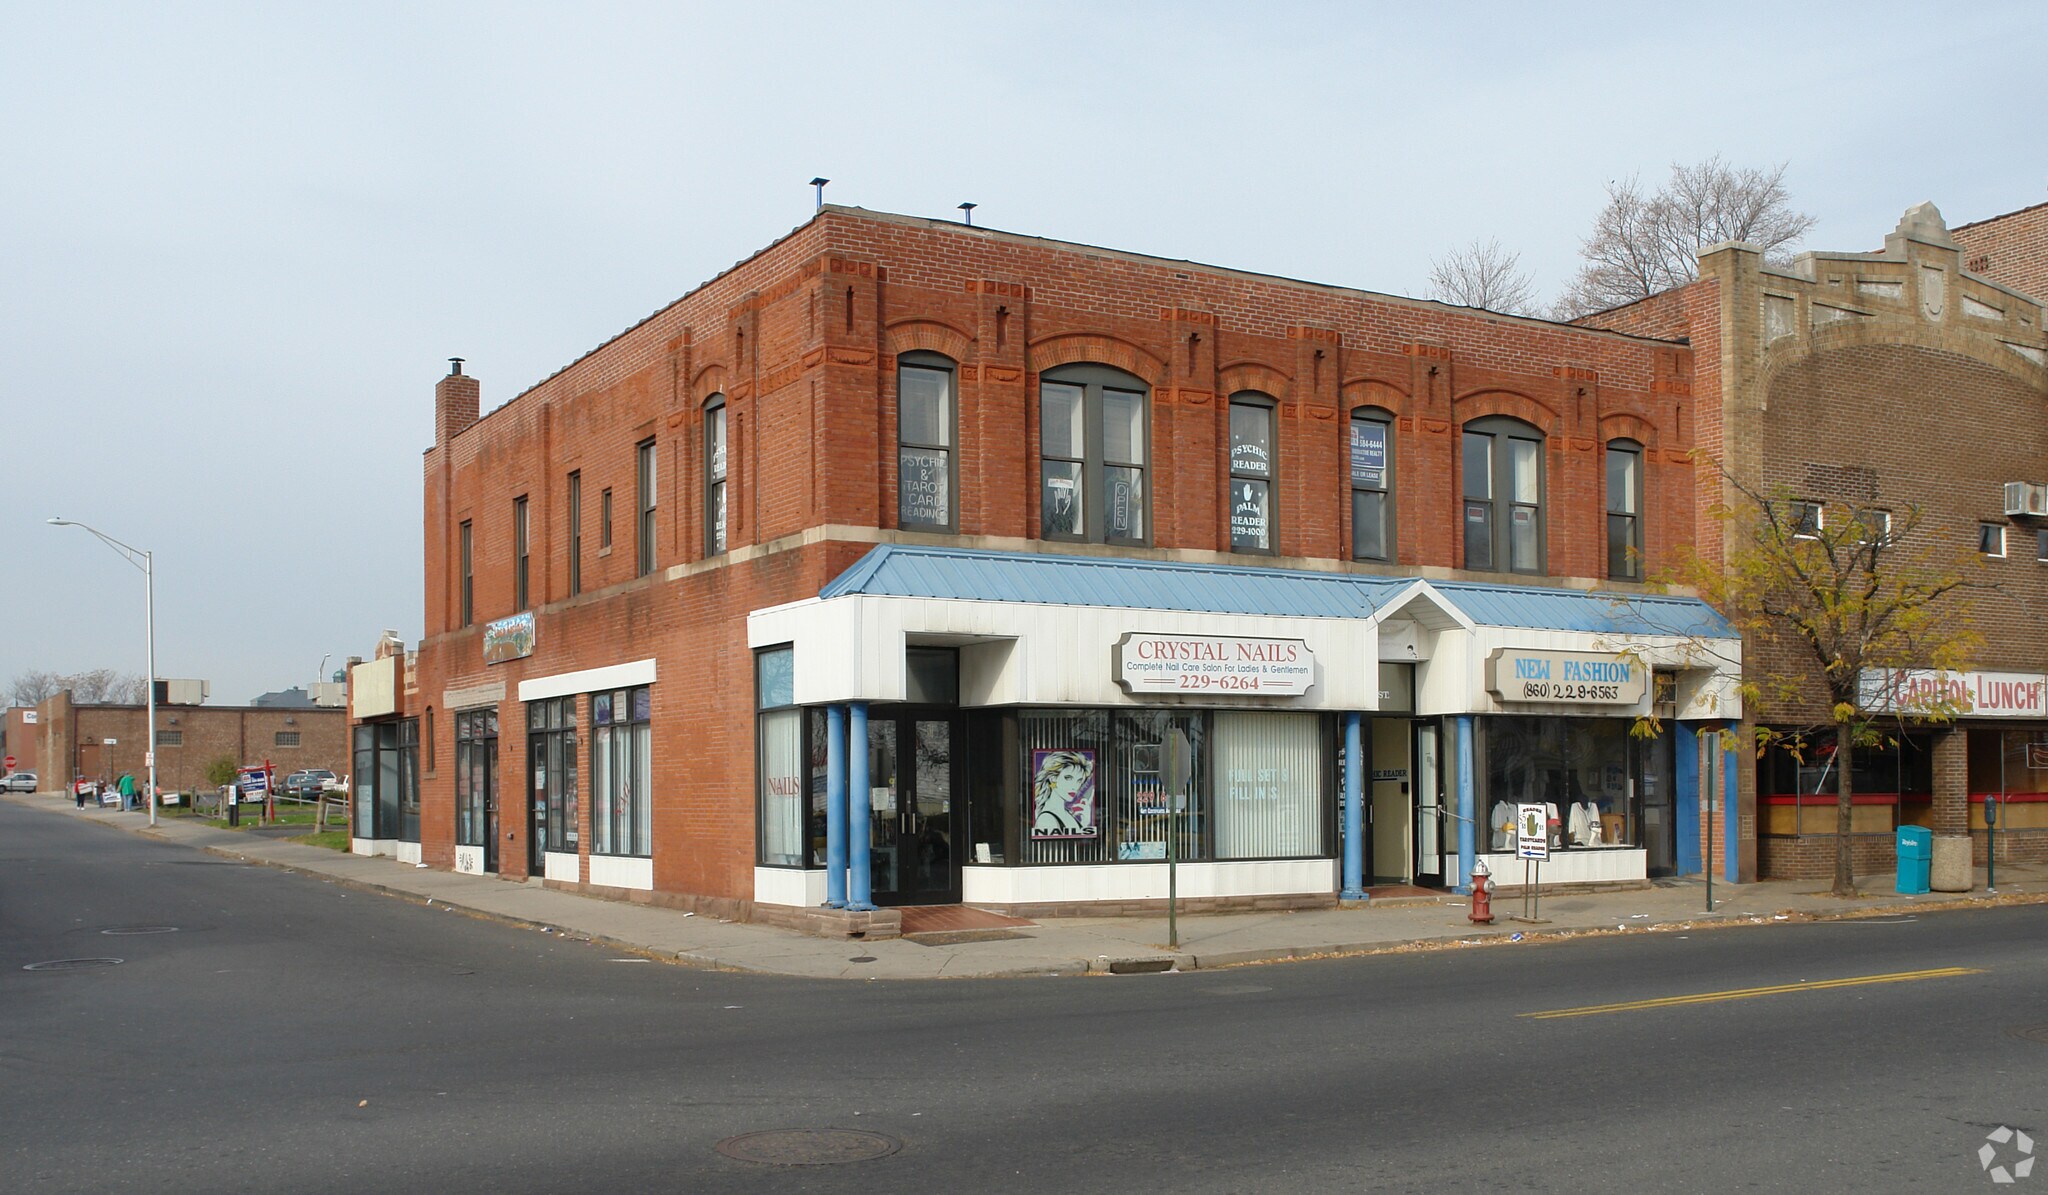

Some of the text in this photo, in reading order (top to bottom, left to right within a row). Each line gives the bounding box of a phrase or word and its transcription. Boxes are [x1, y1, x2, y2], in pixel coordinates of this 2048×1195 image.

[1231, 444, 1268, 461] PSYCHIC
[1232, 459, 1267, 471] READER
[920, 468, 929, 480] &
[1116, 484, 1127, 528] OPEN
[1236, 502, 1260, 515] PALM
[1231, 516, 1266, 527] READER
[1138, 640, 1297, 663] CRYSTAL NAILS
[1126, 662, 1163, 672] Complete
[1165, 663, 1179, 671] Nail
[1182, 664, 1200, 672] Care
[1224, 664, 1235, 673] For
[1237, 665, 1260, 673] Ladies
[1270, 666, 1308, 674] Gentlemen
[1515, 658, 1631, 683] NEW FASHION
[1179, 674, 1259, 690] 229-6264
[1523, 681, 1550, 699] (860)
[1977, 675, 2038, 710] LUNCH
[1383, 769, 1407, 777] READER
[768, 776, 799, 796] NAILS
[1034, 827, 1095, 836] NAILS
